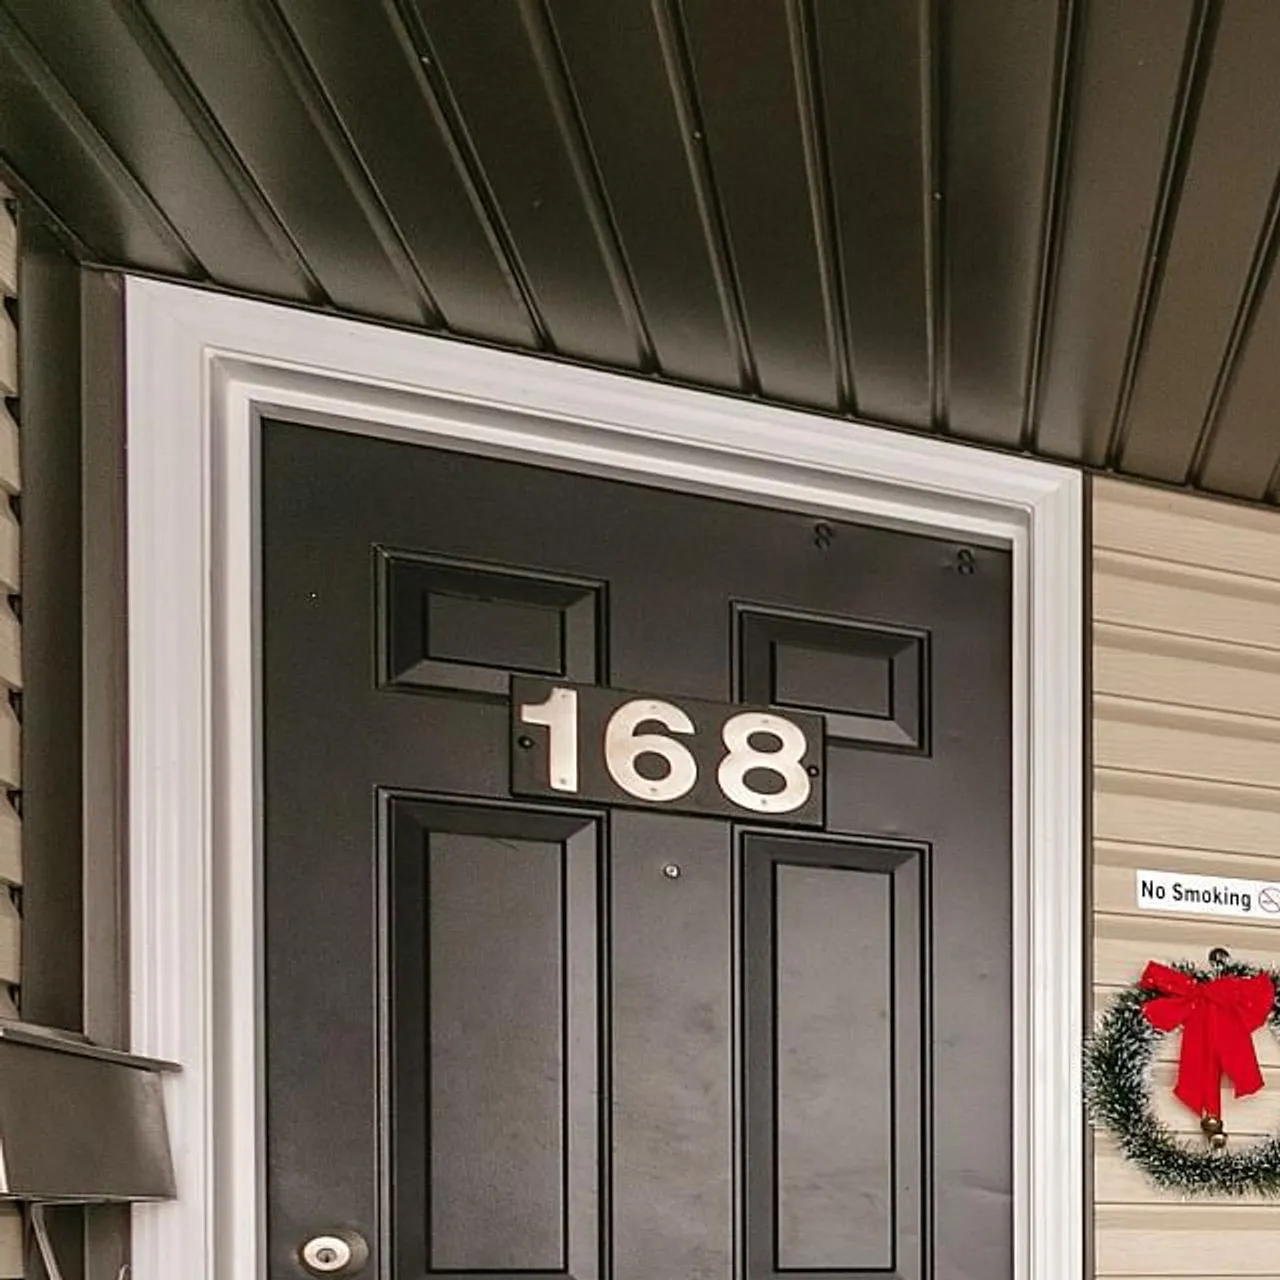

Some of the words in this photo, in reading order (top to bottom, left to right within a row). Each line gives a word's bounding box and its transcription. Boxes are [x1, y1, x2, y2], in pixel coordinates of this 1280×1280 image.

[521, 687, 811, 813] 168
[1141, 879, 1166, 900] No
[1172, 882, 1251, 912] Smoking
